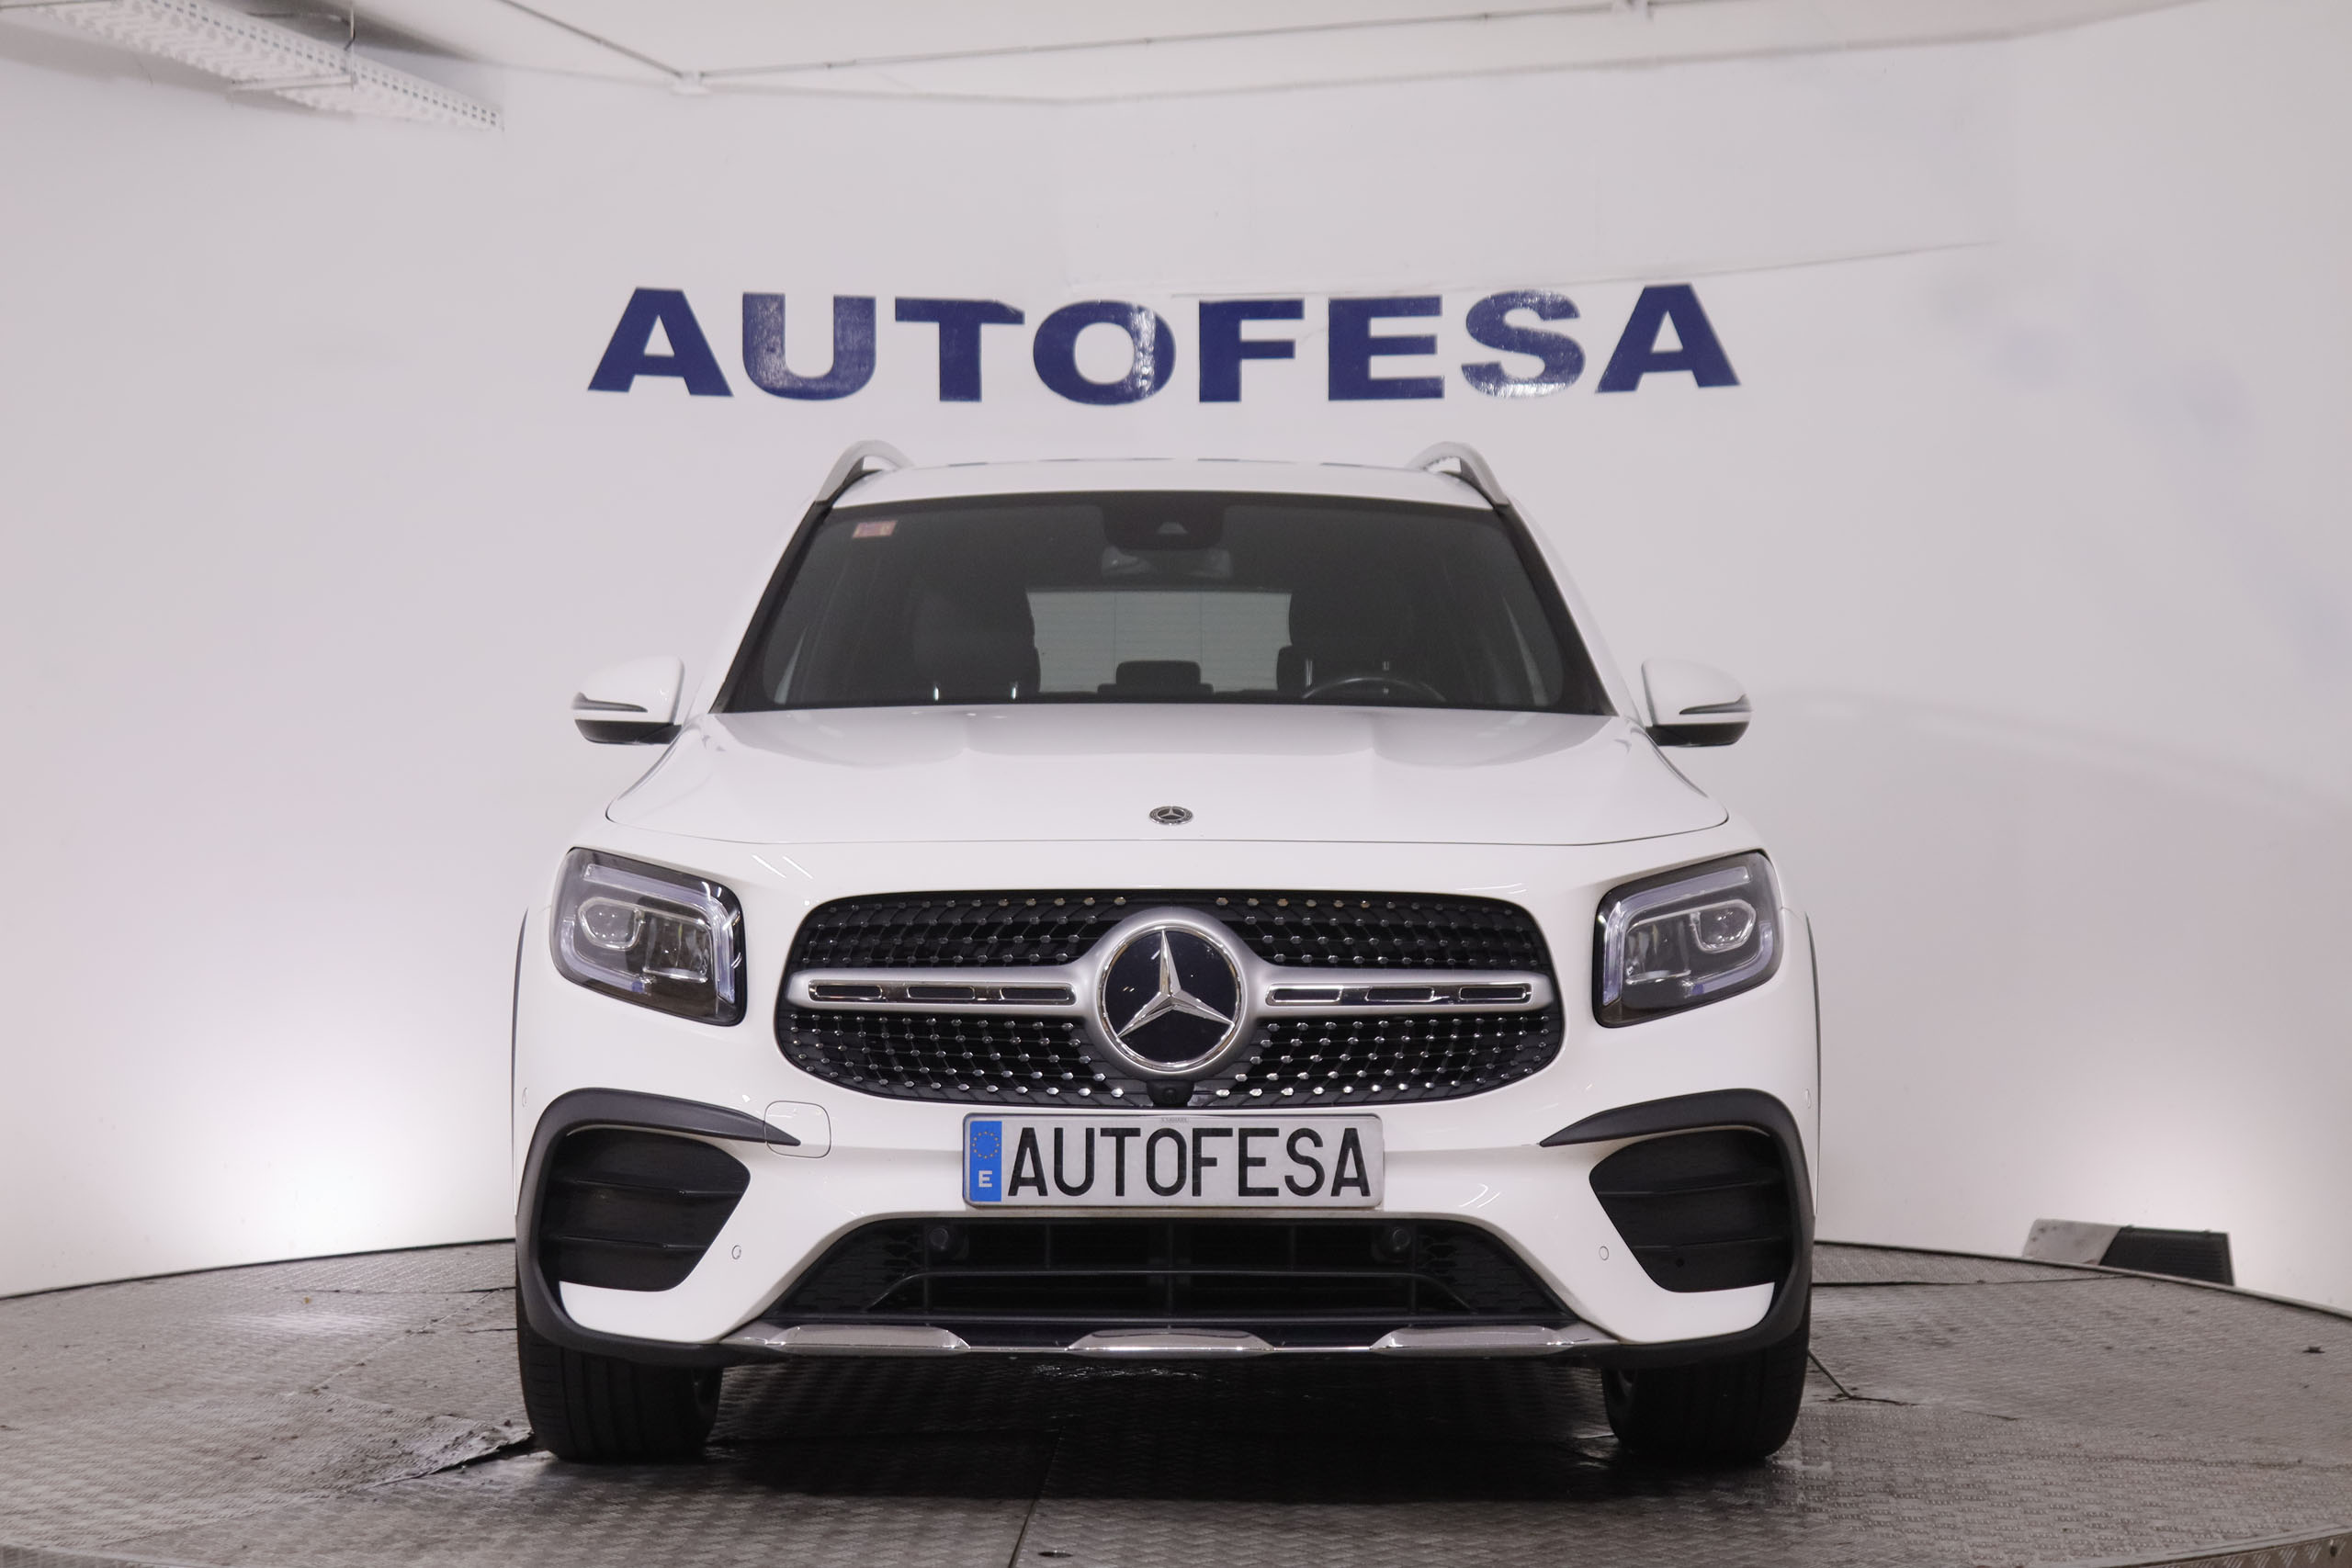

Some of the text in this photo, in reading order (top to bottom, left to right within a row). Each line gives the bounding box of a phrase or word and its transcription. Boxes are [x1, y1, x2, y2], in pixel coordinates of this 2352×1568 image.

[587, 284, 1740, 406] AUTOFESA
[978, 1170, 993, 1188] E
[1007, 1127, 1371, 1197] AUTOFESA
